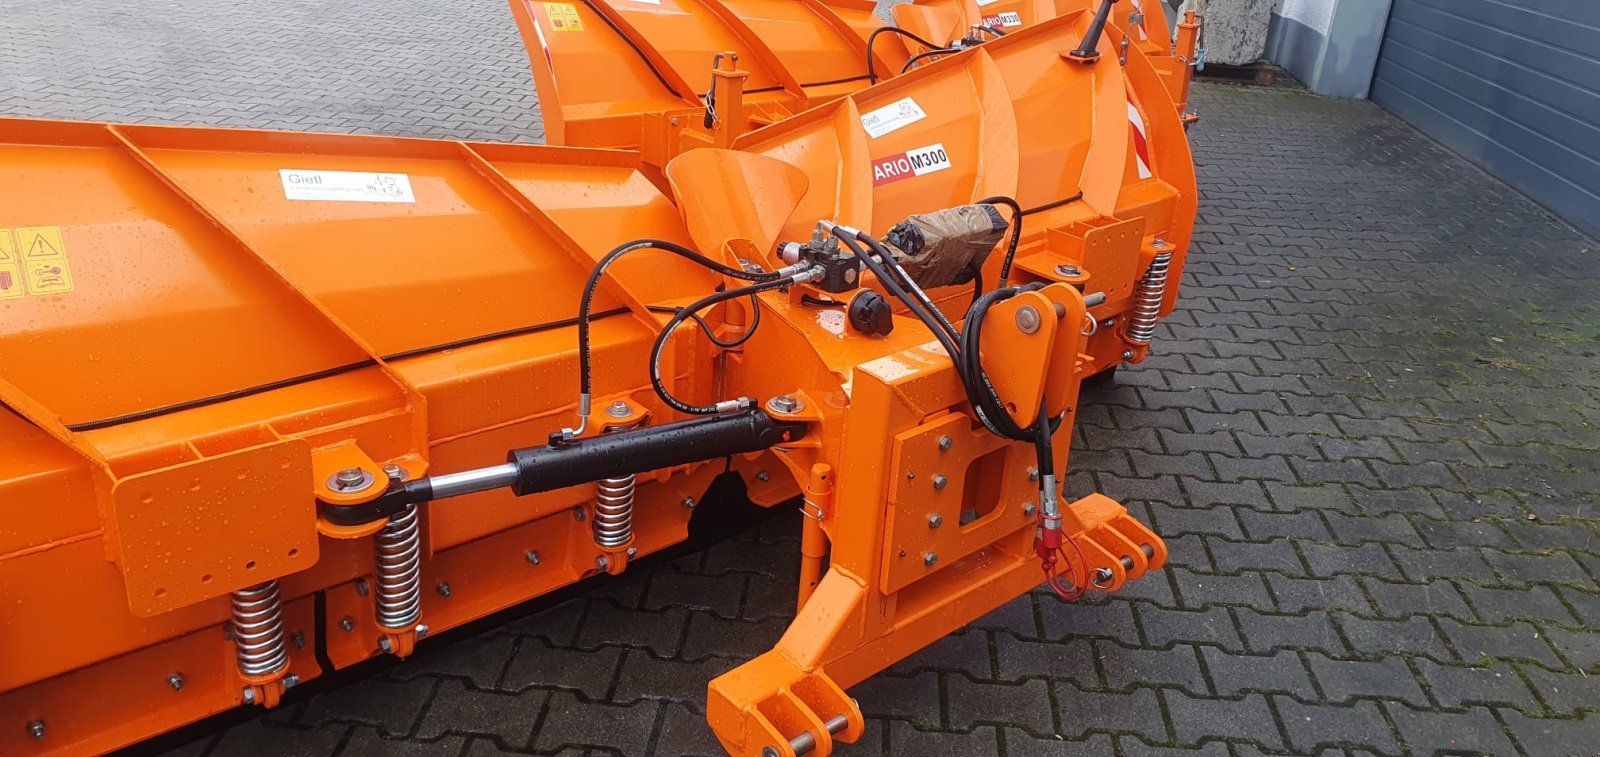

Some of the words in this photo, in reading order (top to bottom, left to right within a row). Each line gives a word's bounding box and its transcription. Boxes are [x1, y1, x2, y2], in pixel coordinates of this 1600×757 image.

[982, 16, 1000, 27] ARIO
[873, 158, 910, 180] ARIO
[910, 149, 946, 170] M300
[288, 173, 322, 185] Gietl
